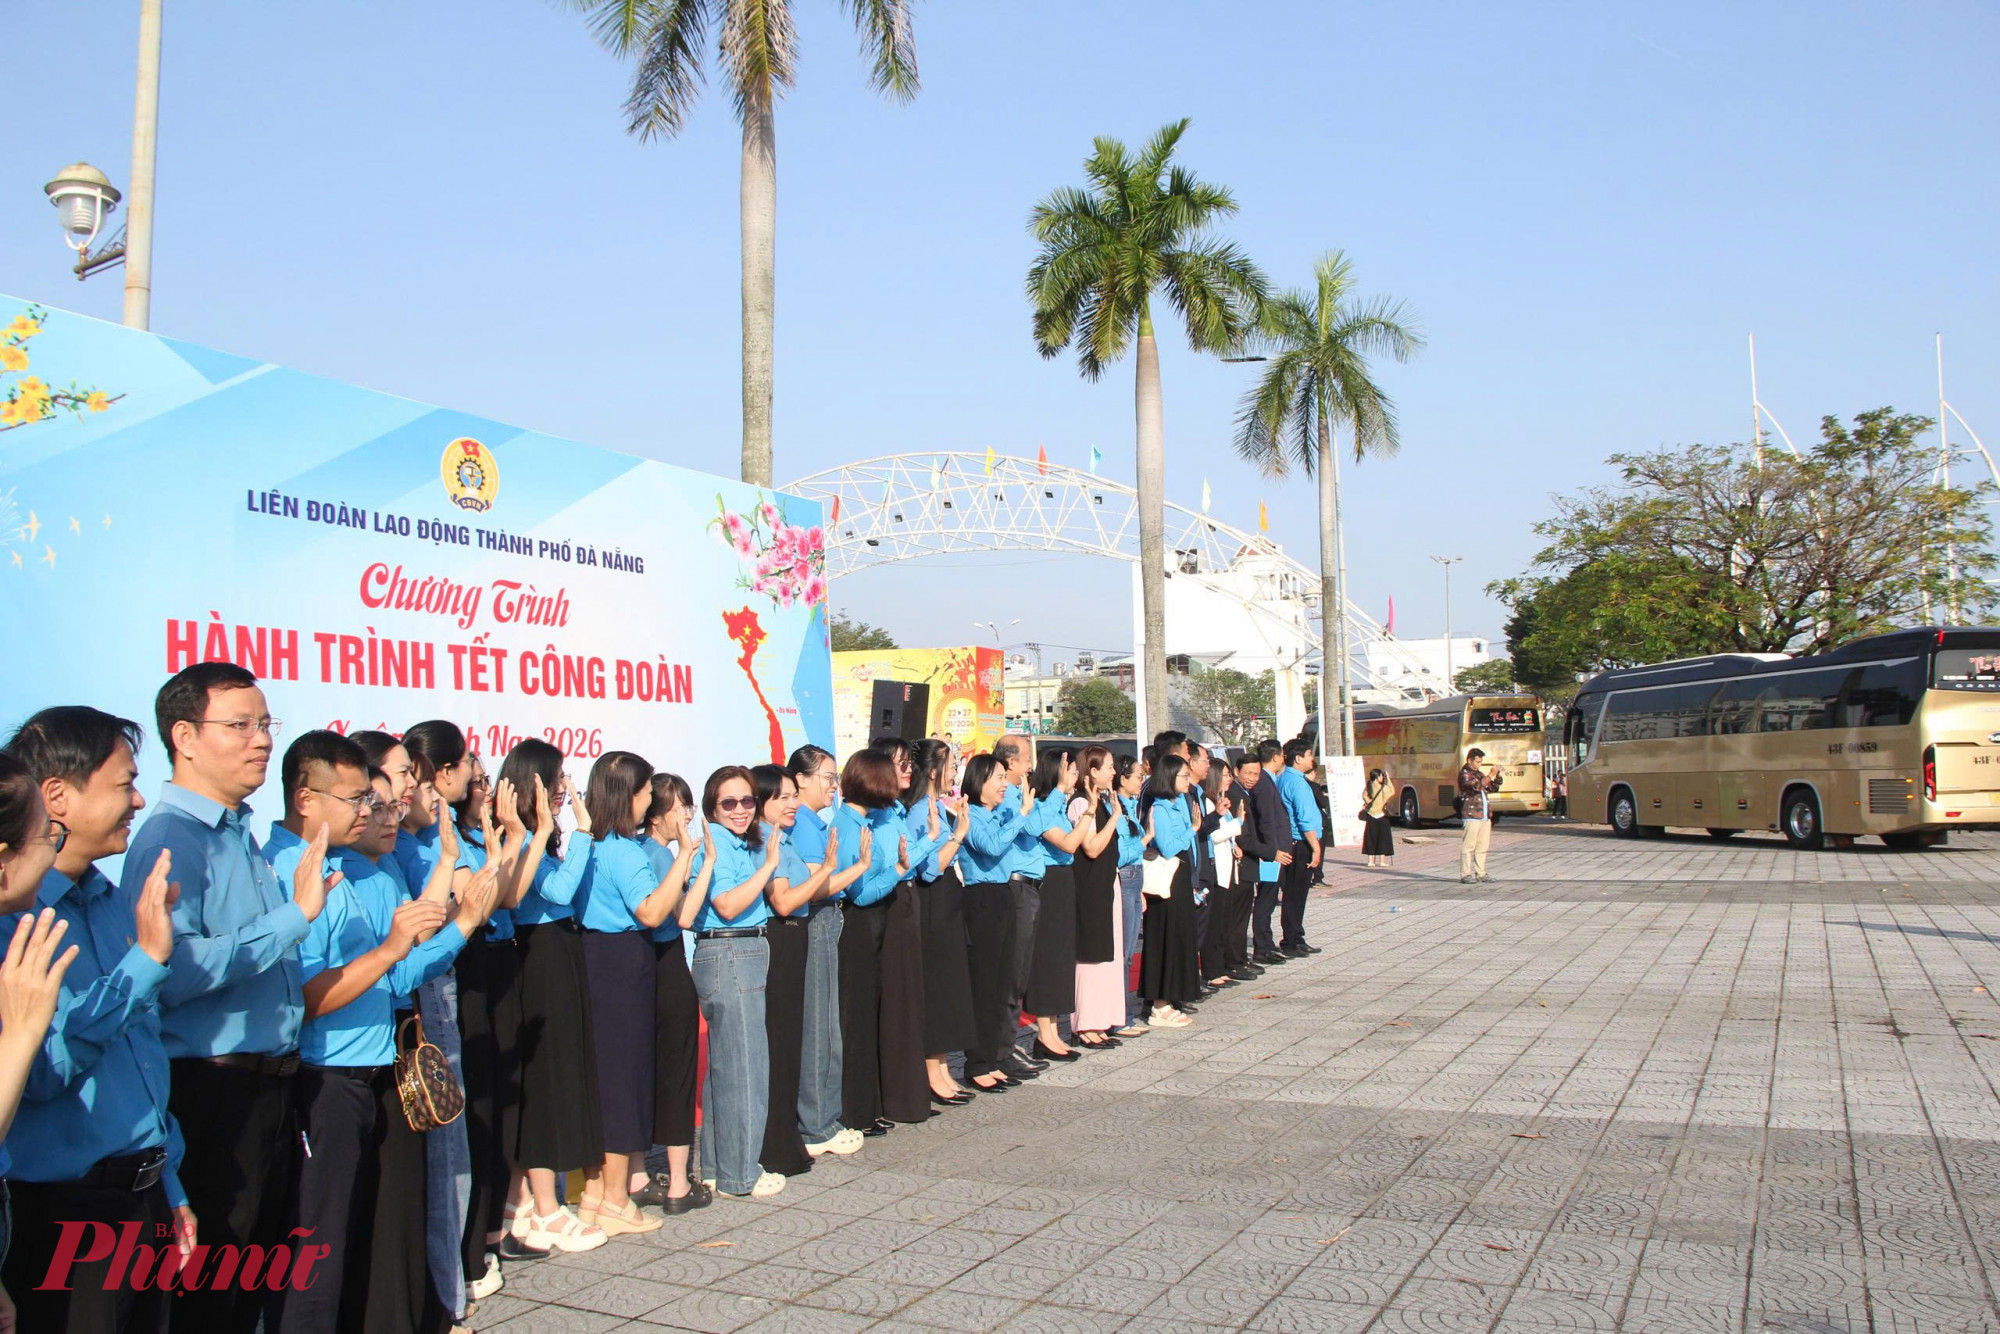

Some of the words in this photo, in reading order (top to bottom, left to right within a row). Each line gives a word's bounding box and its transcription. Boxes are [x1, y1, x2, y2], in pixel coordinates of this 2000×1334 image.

[247, 489, 299, 519] LIÊN
[306, 500, 367, 530] ĐOÀN
[374, 511, 411, 537] LAO
[417, 517, 470, 546] ĐỘNG
[475, 527, 534, 557] THÀNH
[538, 537, 572, 562] PHỐ
[576, 544, 598, 567] ĐÀ
[602, 546, 645, 574] NẴNG
[359, 562, 484, 630] Chương
[491, 579, 572, 628] Trình
[165, 609, 299, 681] HÀNH
[313, 625, 436, 690] TRÌNH
[447, 632, 508, 694] TẾT
[519, 643, 606, 700] CÔNG
[614, 654, 693, 704] ĐOÀN
[543, 726, 603, 758] 2026
